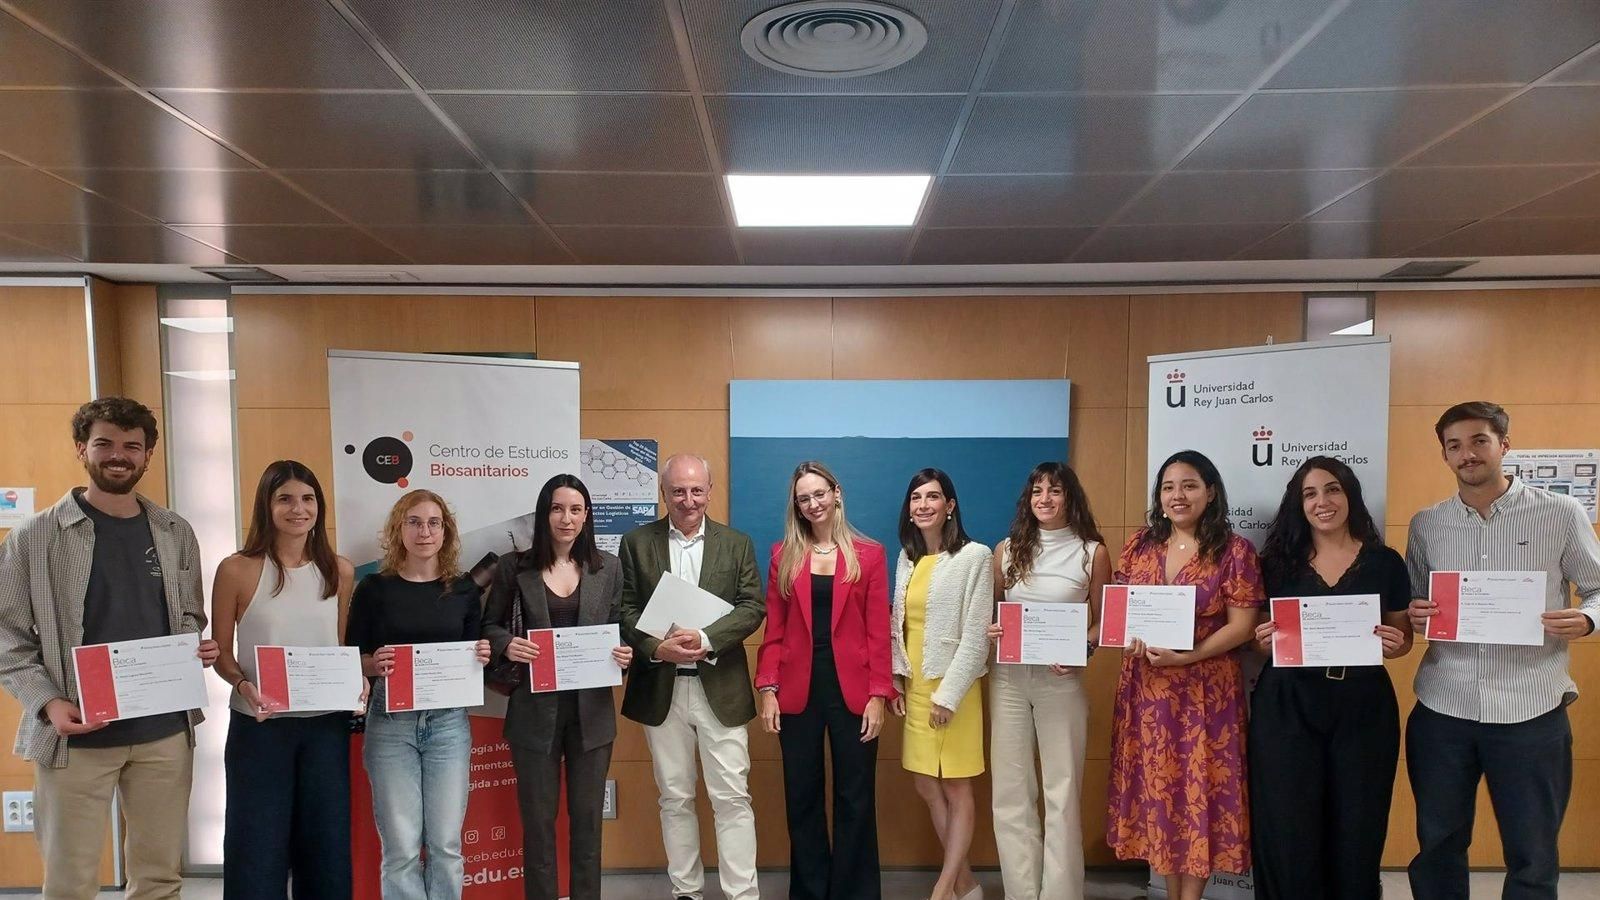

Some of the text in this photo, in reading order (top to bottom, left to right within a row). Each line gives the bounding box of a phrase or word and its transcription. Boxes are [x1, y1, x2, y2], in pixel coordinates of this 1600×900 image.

[1193, 381, 1255, 394] Universidad
[1193, 393, 1274, 408] Rey Juan Carlos
[429, 444, 569, 459] Centro de Estudios
[1281, 441, 1348, 452] Universidad
[376, 454, 400, 465] CEB
[1281, 456, 1302, 467] Rey
[430, 463, 529, 477] Biosanitarios
[632, 506, 649, 515] SAP
[1226, 507, 1253, 516] sidad
[1239, 519, 1271, 530] Carlos
[1461, 585, 1482, 593] Beca
[1129, 597, 1146, 605] Beca
[1023, 613, 1040, 622] Beca
[1302, 610, 1322, 618] Beca
[113, 657, 136, 666] Beca
[414, 657, 433, 665] Beca
[470, 760, 514, 771] imentac
[468, 780, 491, 791] gida
[501, 777, 518, 785] em
[464, 848, 524, 863] ceb.edu.e
[1212, 874, 1254, 890] Juan Car
